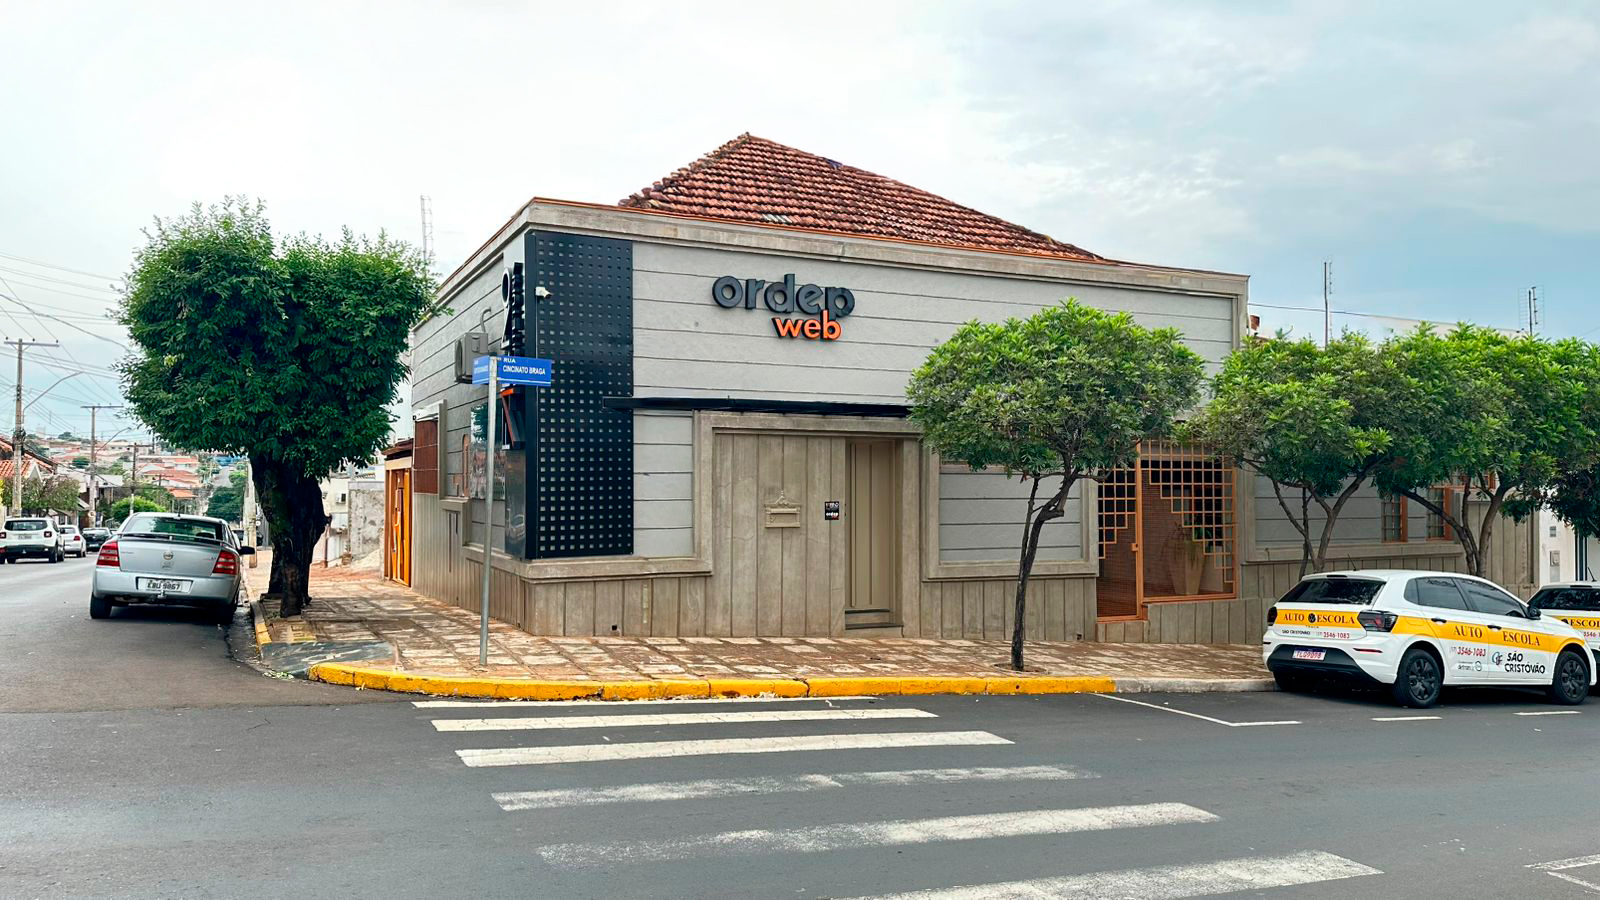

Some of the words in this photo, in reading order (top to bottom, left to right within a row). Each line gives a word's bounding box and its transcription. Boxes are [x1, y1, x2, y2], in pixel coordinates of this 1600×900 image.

[712, 273, 855, 319] ordep
[771, 309, 842, 341] web
[502, 365, 528, 374] CINCINATO
[529, 367, 546, 375] BRAGA
[1284, 613, 1304, 621] AUTO
[1317, 614, 1355, 624] ESCOLA
[1454, 625, 1483, 639] AUTO
[1503, 632, 1541, 646] ESCOLA
[1507, 651, 1524, 662] SÃO
[1505, 662, 1546, 674] CRISTÓVÃO
